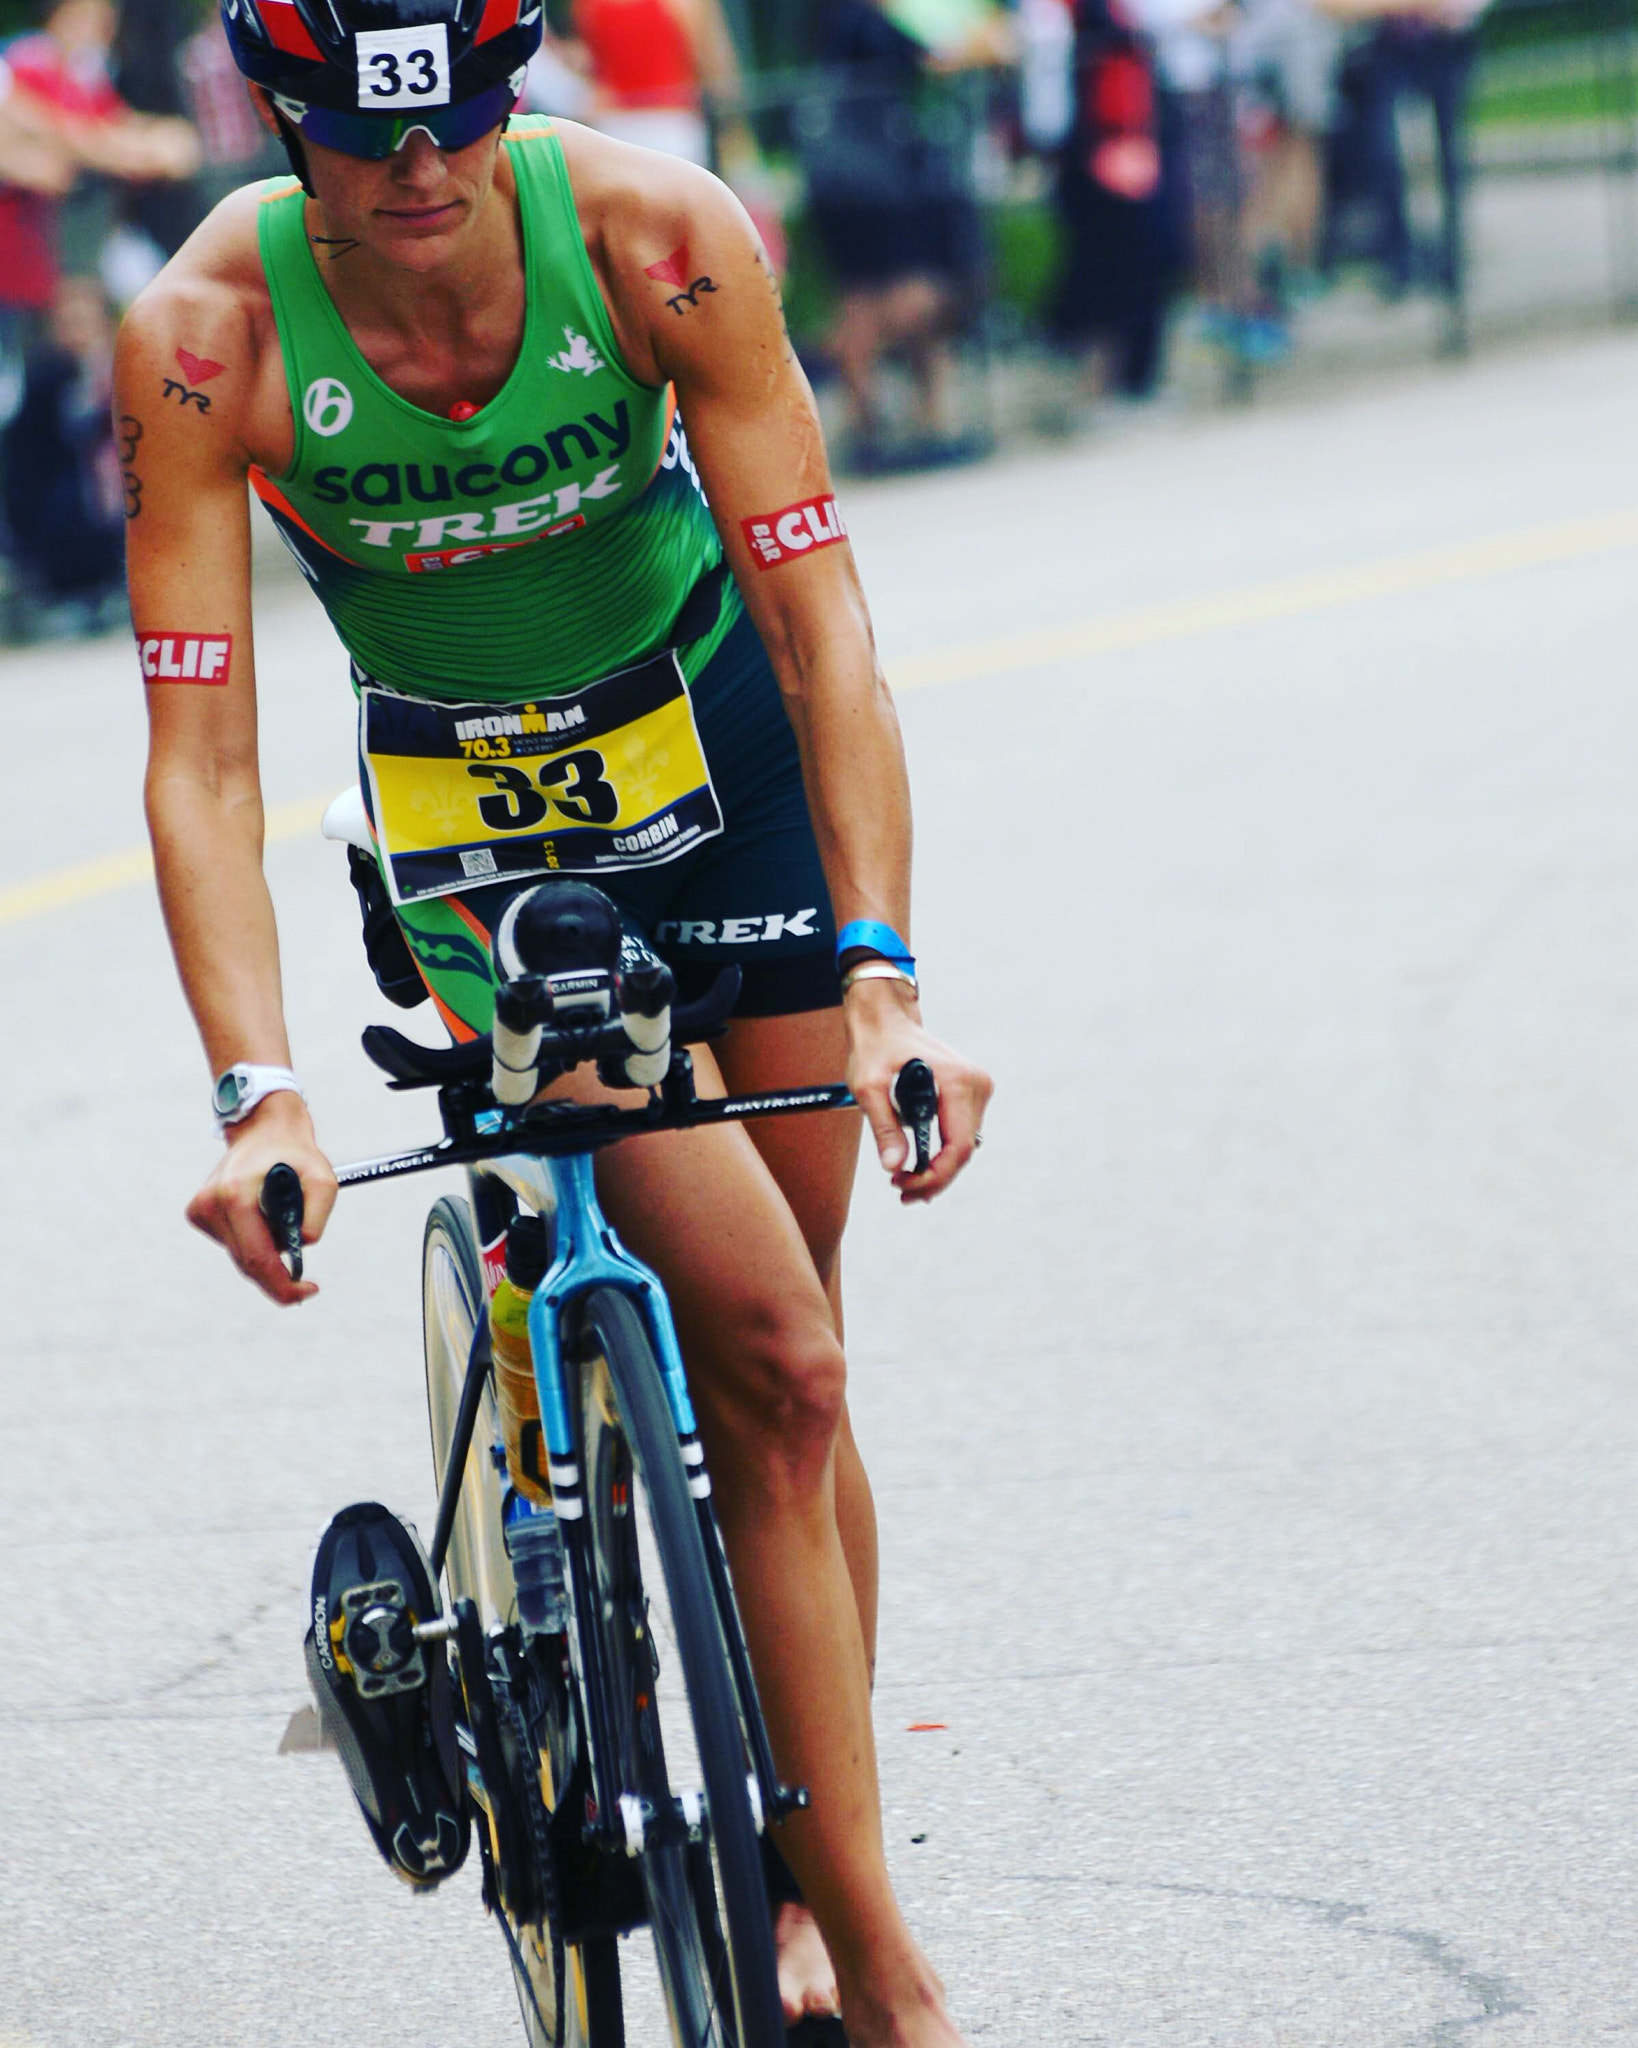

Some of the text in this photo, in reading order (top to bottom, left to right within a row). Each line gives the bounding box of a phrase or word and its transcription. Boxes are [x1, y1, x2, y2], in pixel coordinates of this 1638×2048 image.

[369, 48, 438, 97] 33
[665, 276, 718, 315] TYR
[163, 378, 211, 415] TYR
[313, 400, 631, 506] saucony
[350, 464, 623, 547] TREK
[751, 524, 782, 562] BAR
[142, 639, 228, 679] CLIF
[455, 703, 585, 741] IRONMAN
[459, 737, 511, 759] 70.3
[466, 749, 618, 831] 33
[613, 813, 679, 852] CORBIN
[656, 907, 818, 944] TREK
[551, 979, 598, 993] GARMIN
[314, 1596, 333, 1670] CARBON
